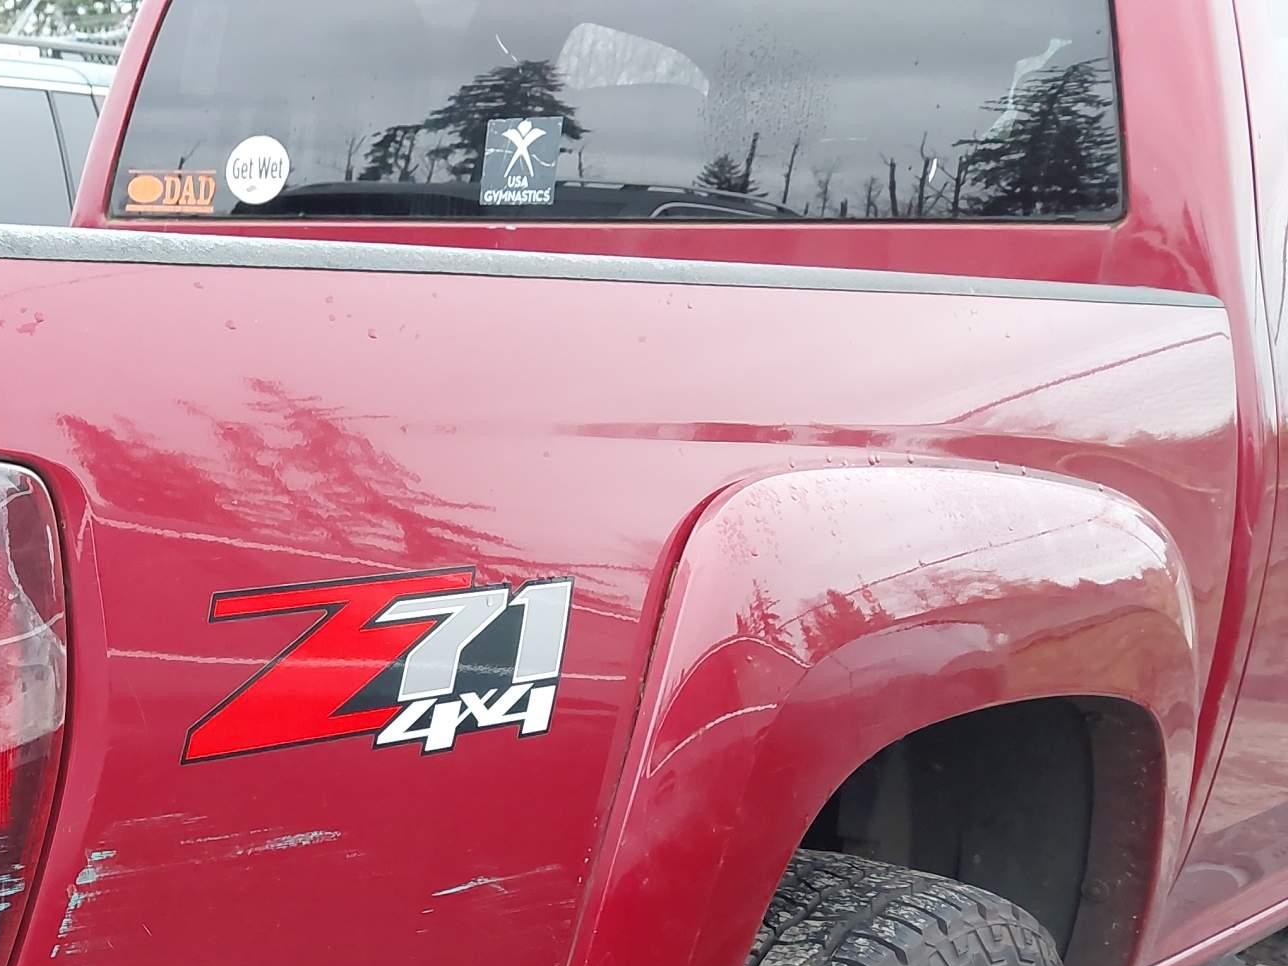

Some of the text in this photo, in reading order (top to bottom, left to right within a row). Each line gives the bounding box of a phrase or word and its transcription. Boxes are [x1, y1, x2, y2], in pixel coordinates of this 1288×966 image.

[233, 156, 283, 179] Get Wet
[163, 175, 216, 205] DAD
[507, 175, 529, 188] USA
[483, 189, 551, 204] GYMNASTICS
[181, 566, 574, 765] Z71
